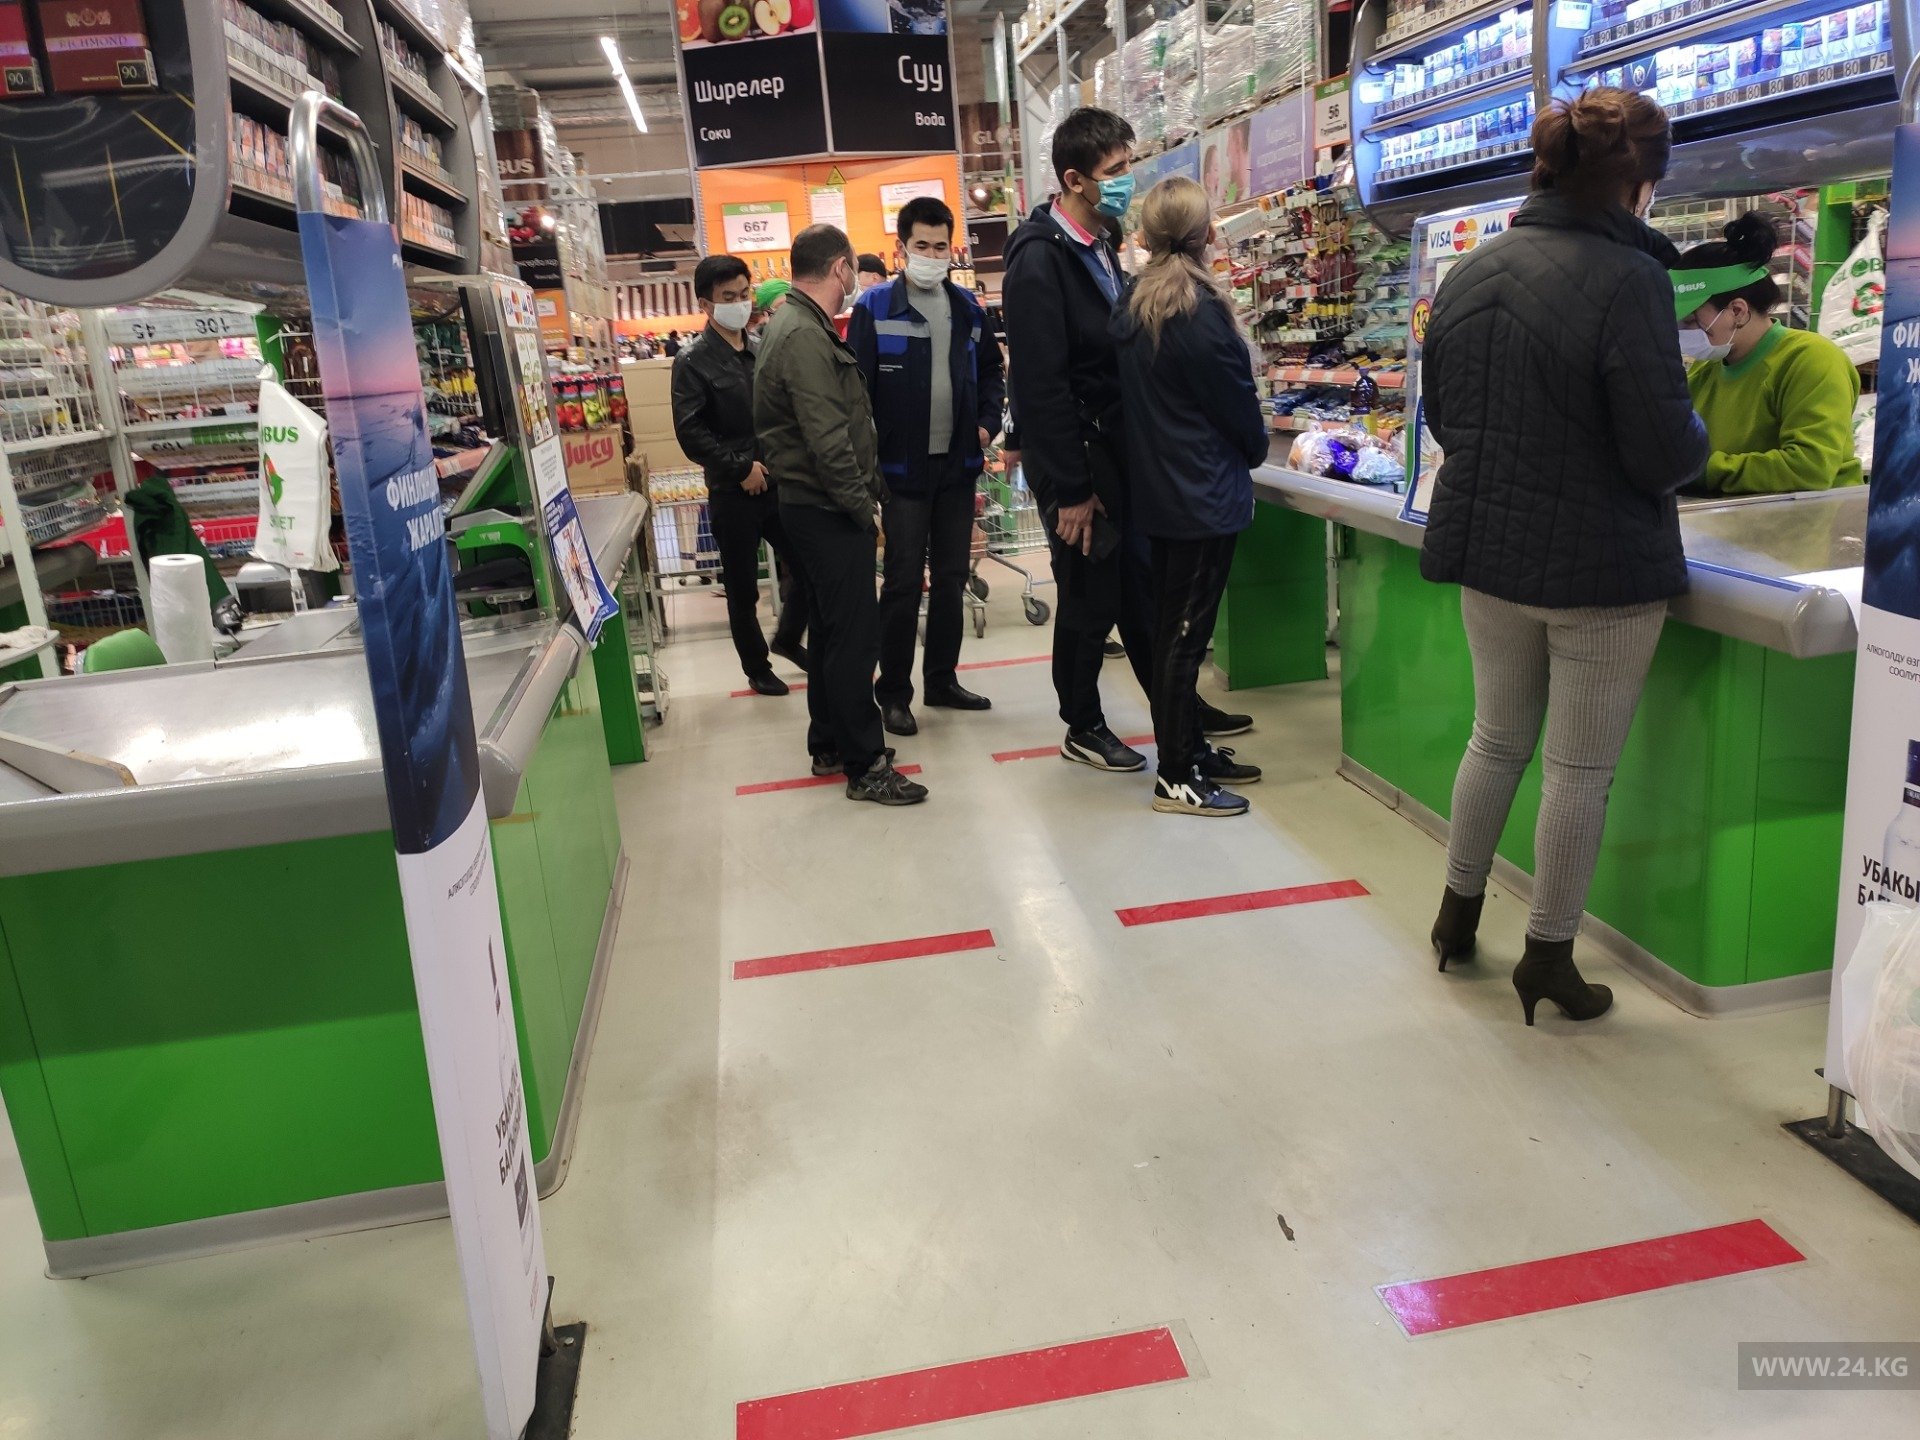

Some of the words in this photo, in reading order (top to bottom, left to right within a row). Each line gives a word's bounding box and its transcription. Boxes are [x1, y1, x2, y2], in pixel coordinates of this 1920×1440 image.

[1844, 62, 1859, 76] 80
[1870, 55, 1887, 70] 75
[8, 72, 24, 86] 90
[121, 65, 138, 79] 90
[898, 55, 943, 92] Суу
[1818, 67, 1833, 81] 80
[1769, 79, 1783, 93] 80
[1793, 72, 1808, 87] 80
[694, 76, 785, 105] Ширелер
[1725, 90, 1738, 105] 80
[1747, 85, 1761, 99] 80
[1685, 100, 1697, 114] 80
[1705, 95, 1717, 109] 85
[915, 112, 946, 126] Вода
[700, 127, 731, 142] Соки
[743, 221, 768, 232] 667
[1430, 230, 1452, 248] VISA
[261, 426, 299, 444] BUS
[565, 432, 614, 469] Juicy
[1862, 854, 1920, 903] УБАКЫ
